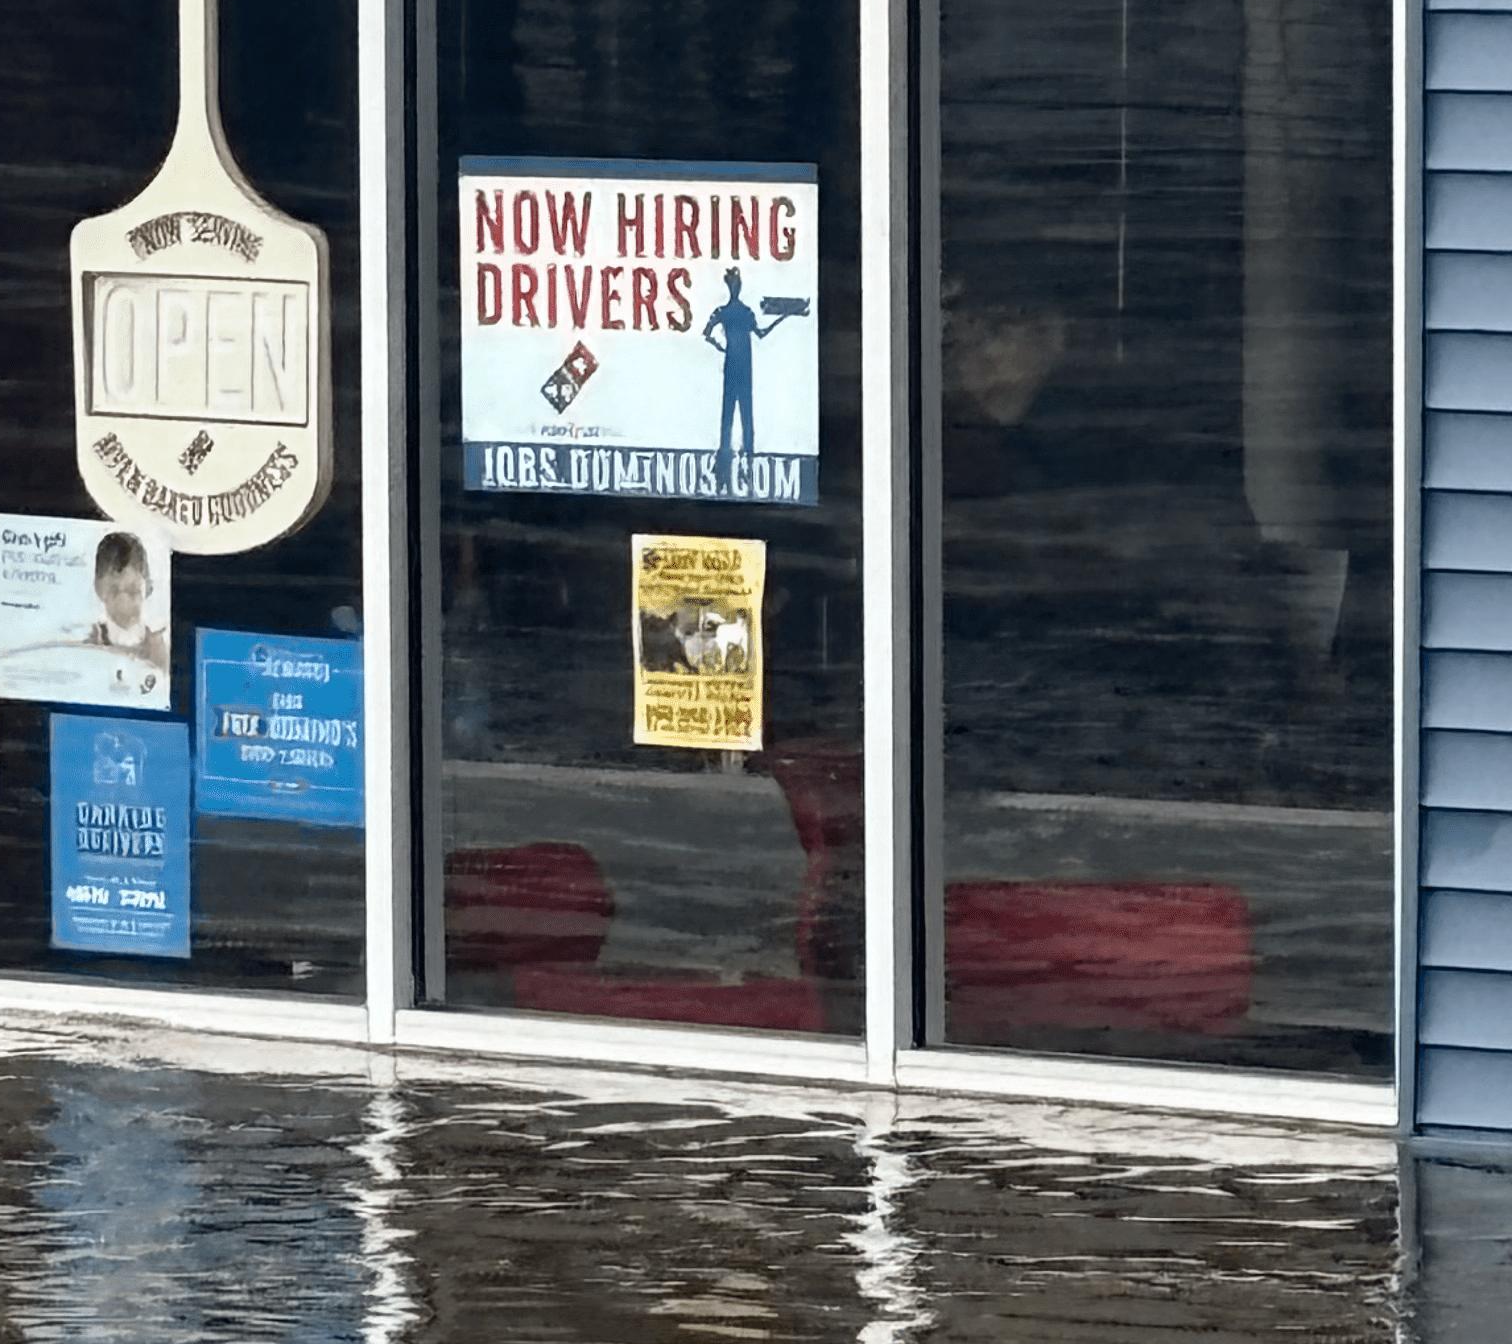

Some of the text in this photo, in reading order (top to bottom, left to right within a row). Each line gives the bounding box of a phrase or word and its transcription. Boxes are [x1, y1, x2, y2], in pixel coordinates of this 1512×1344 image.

[476, 189, 796, 261] NOW HIRING
[476, 262, 692, 332] DRIVERS
[101, 281, 299, 413] OPEN
[481, 446, 802, 501] JOBS.DOMINOS.COM
